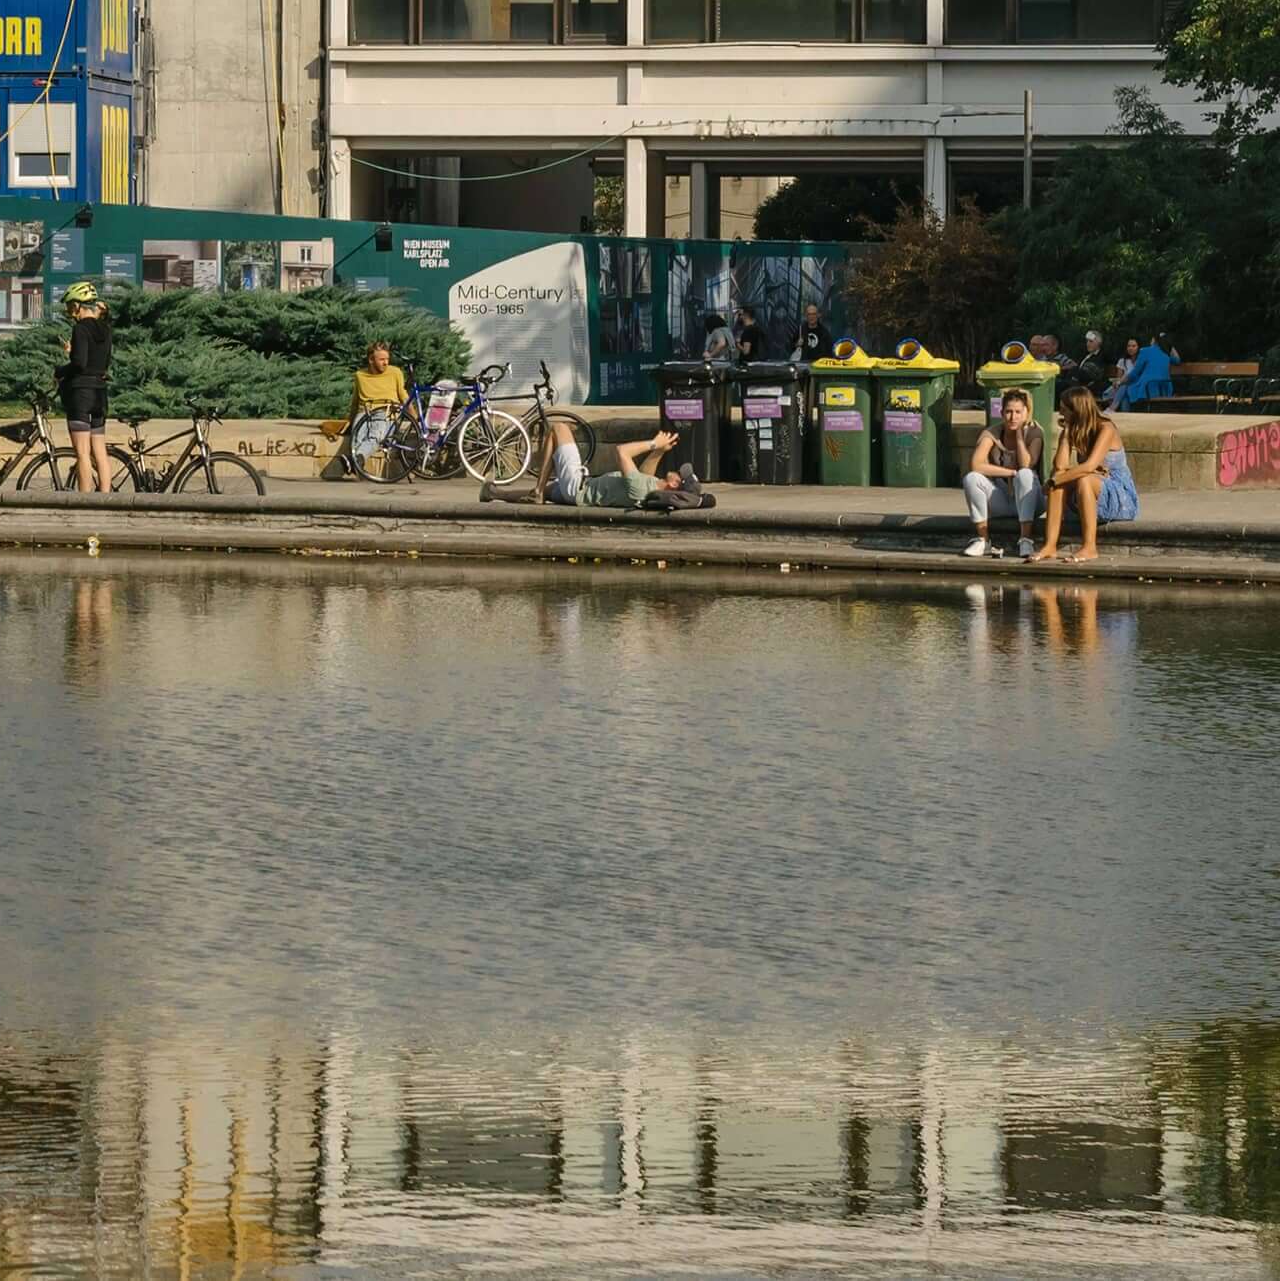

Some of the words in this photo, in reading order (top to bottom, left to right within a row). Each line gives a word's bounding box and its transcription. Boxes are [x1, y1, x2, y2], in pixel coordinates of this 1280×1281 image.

[403, 239, 421, 250] WIEN
[421, 239, 450, 250] MUSEUM
[403, 249, 443, 259] KARLSPLATZ
[419, 258, 438, 269] OPEN
[438, 258, 450, 269] AIR
[457, 285, 564, 303] Mid-Century
